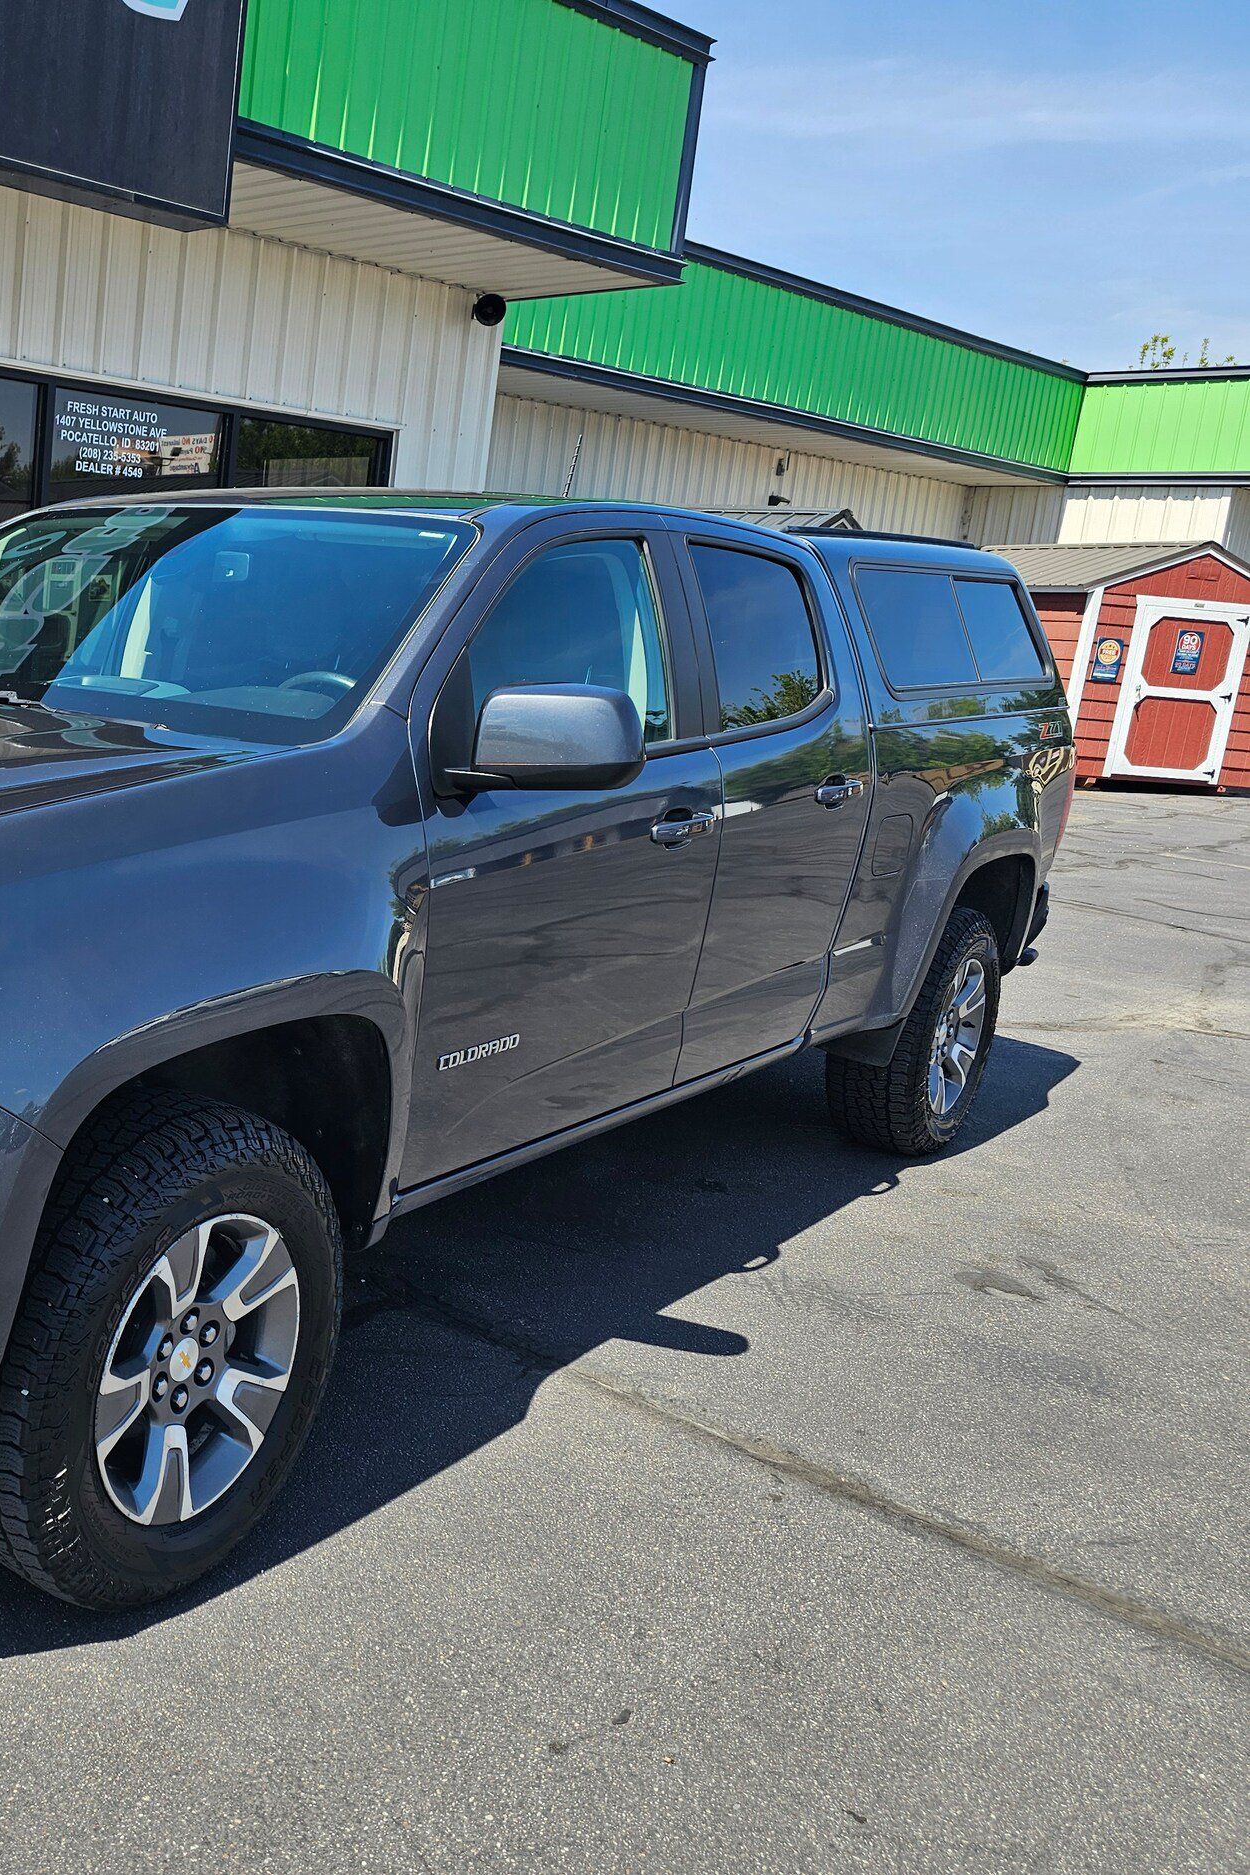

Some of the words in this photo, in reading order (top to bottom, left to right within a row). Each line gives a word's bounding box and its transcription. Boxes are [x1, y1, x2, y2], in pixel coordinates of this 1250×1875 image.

[67, 401, 99, 415] FRESH
[101, 406, 131, 420] START
[132, 411, 158, 424] AUTO
[55, 414, 76, 427] 1407
[79, 417, 148, 437] YELLOWSTONE
[149, 427, 168, 438] AVE
[60, 430, 119, 448] POCATELLO,
[121, 438, 131, 448] ID
[135, 439, 160, 452] 83201
[79, 447, 101, 461] (208)
[103, 450, 141, 464] 235-5353
[75, 460, 113, 475] DEALER
[115, 466, 121, 476] #
[122, 467, 143, 478] 4549
[1183, 635, 1198, 645] 90
[1039, 721, 1063, 739] Z71
[438, 1033, 520, 1071] COLORADO
